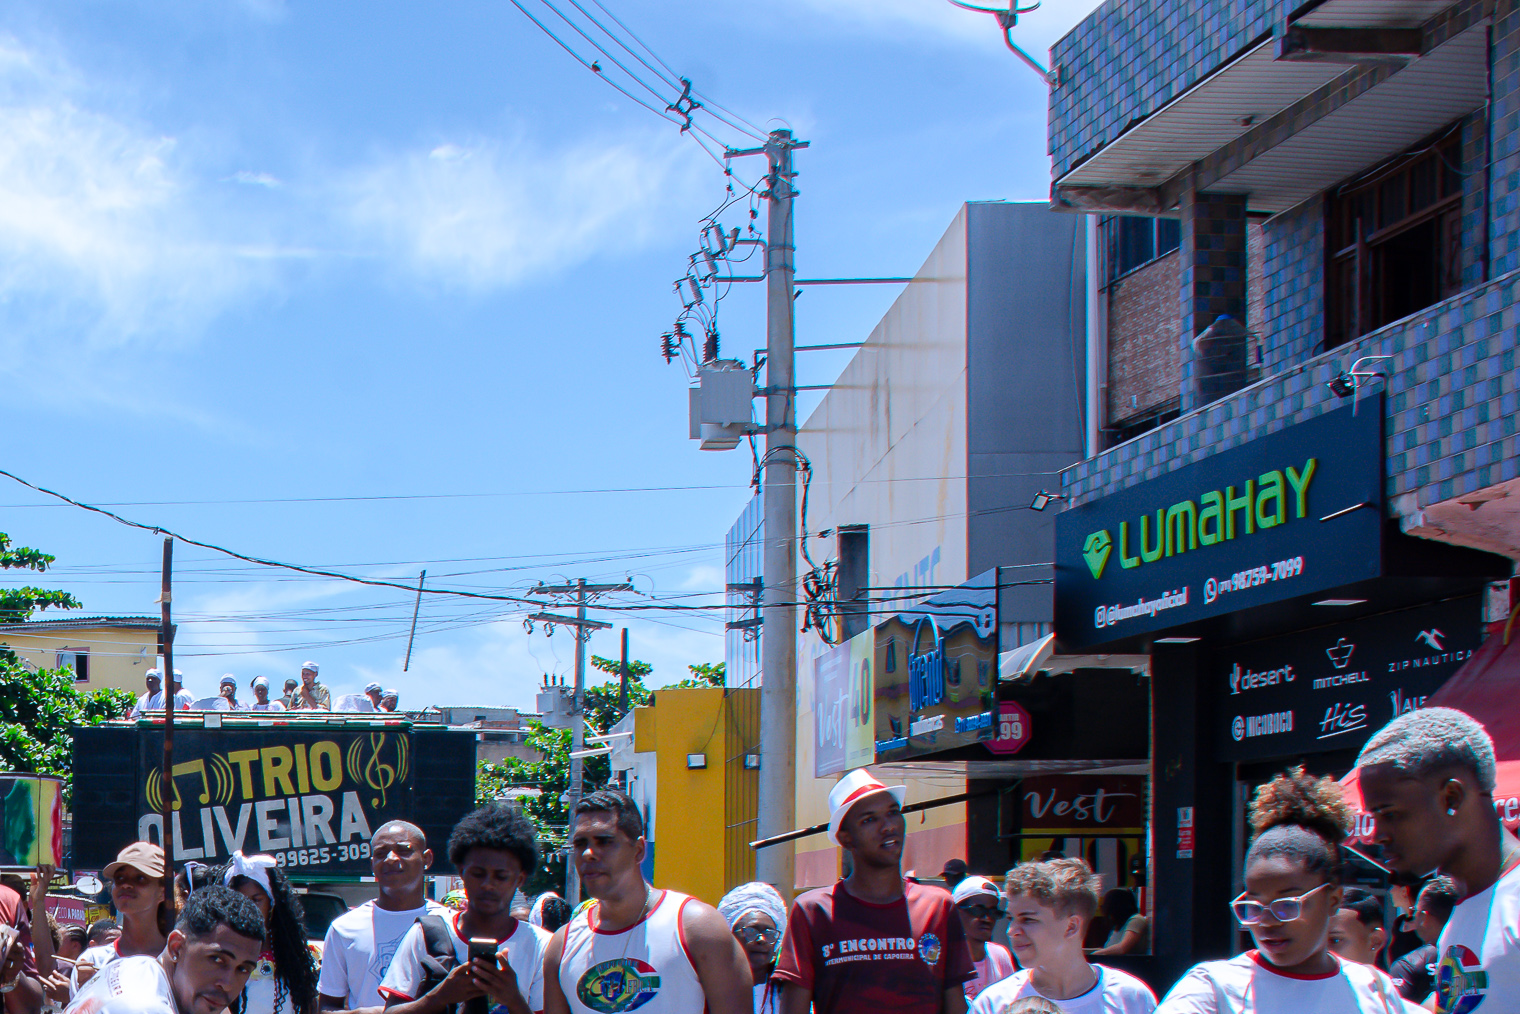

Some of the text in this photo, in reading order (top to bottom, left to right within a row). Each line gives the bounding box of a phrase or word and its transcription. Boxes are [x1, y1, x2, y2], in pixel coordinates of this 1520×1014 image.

[1241, 664, 1297, 691] desert
[1312, 671, 1371, 690] MITCHELL
[228, 740, 343, 800] TRIO
[1024, 788, 1137, 823] Vest
[138, 790, 373, 862] OLIVEIRA
[839, 937, 916, 954] ENCONTRO
